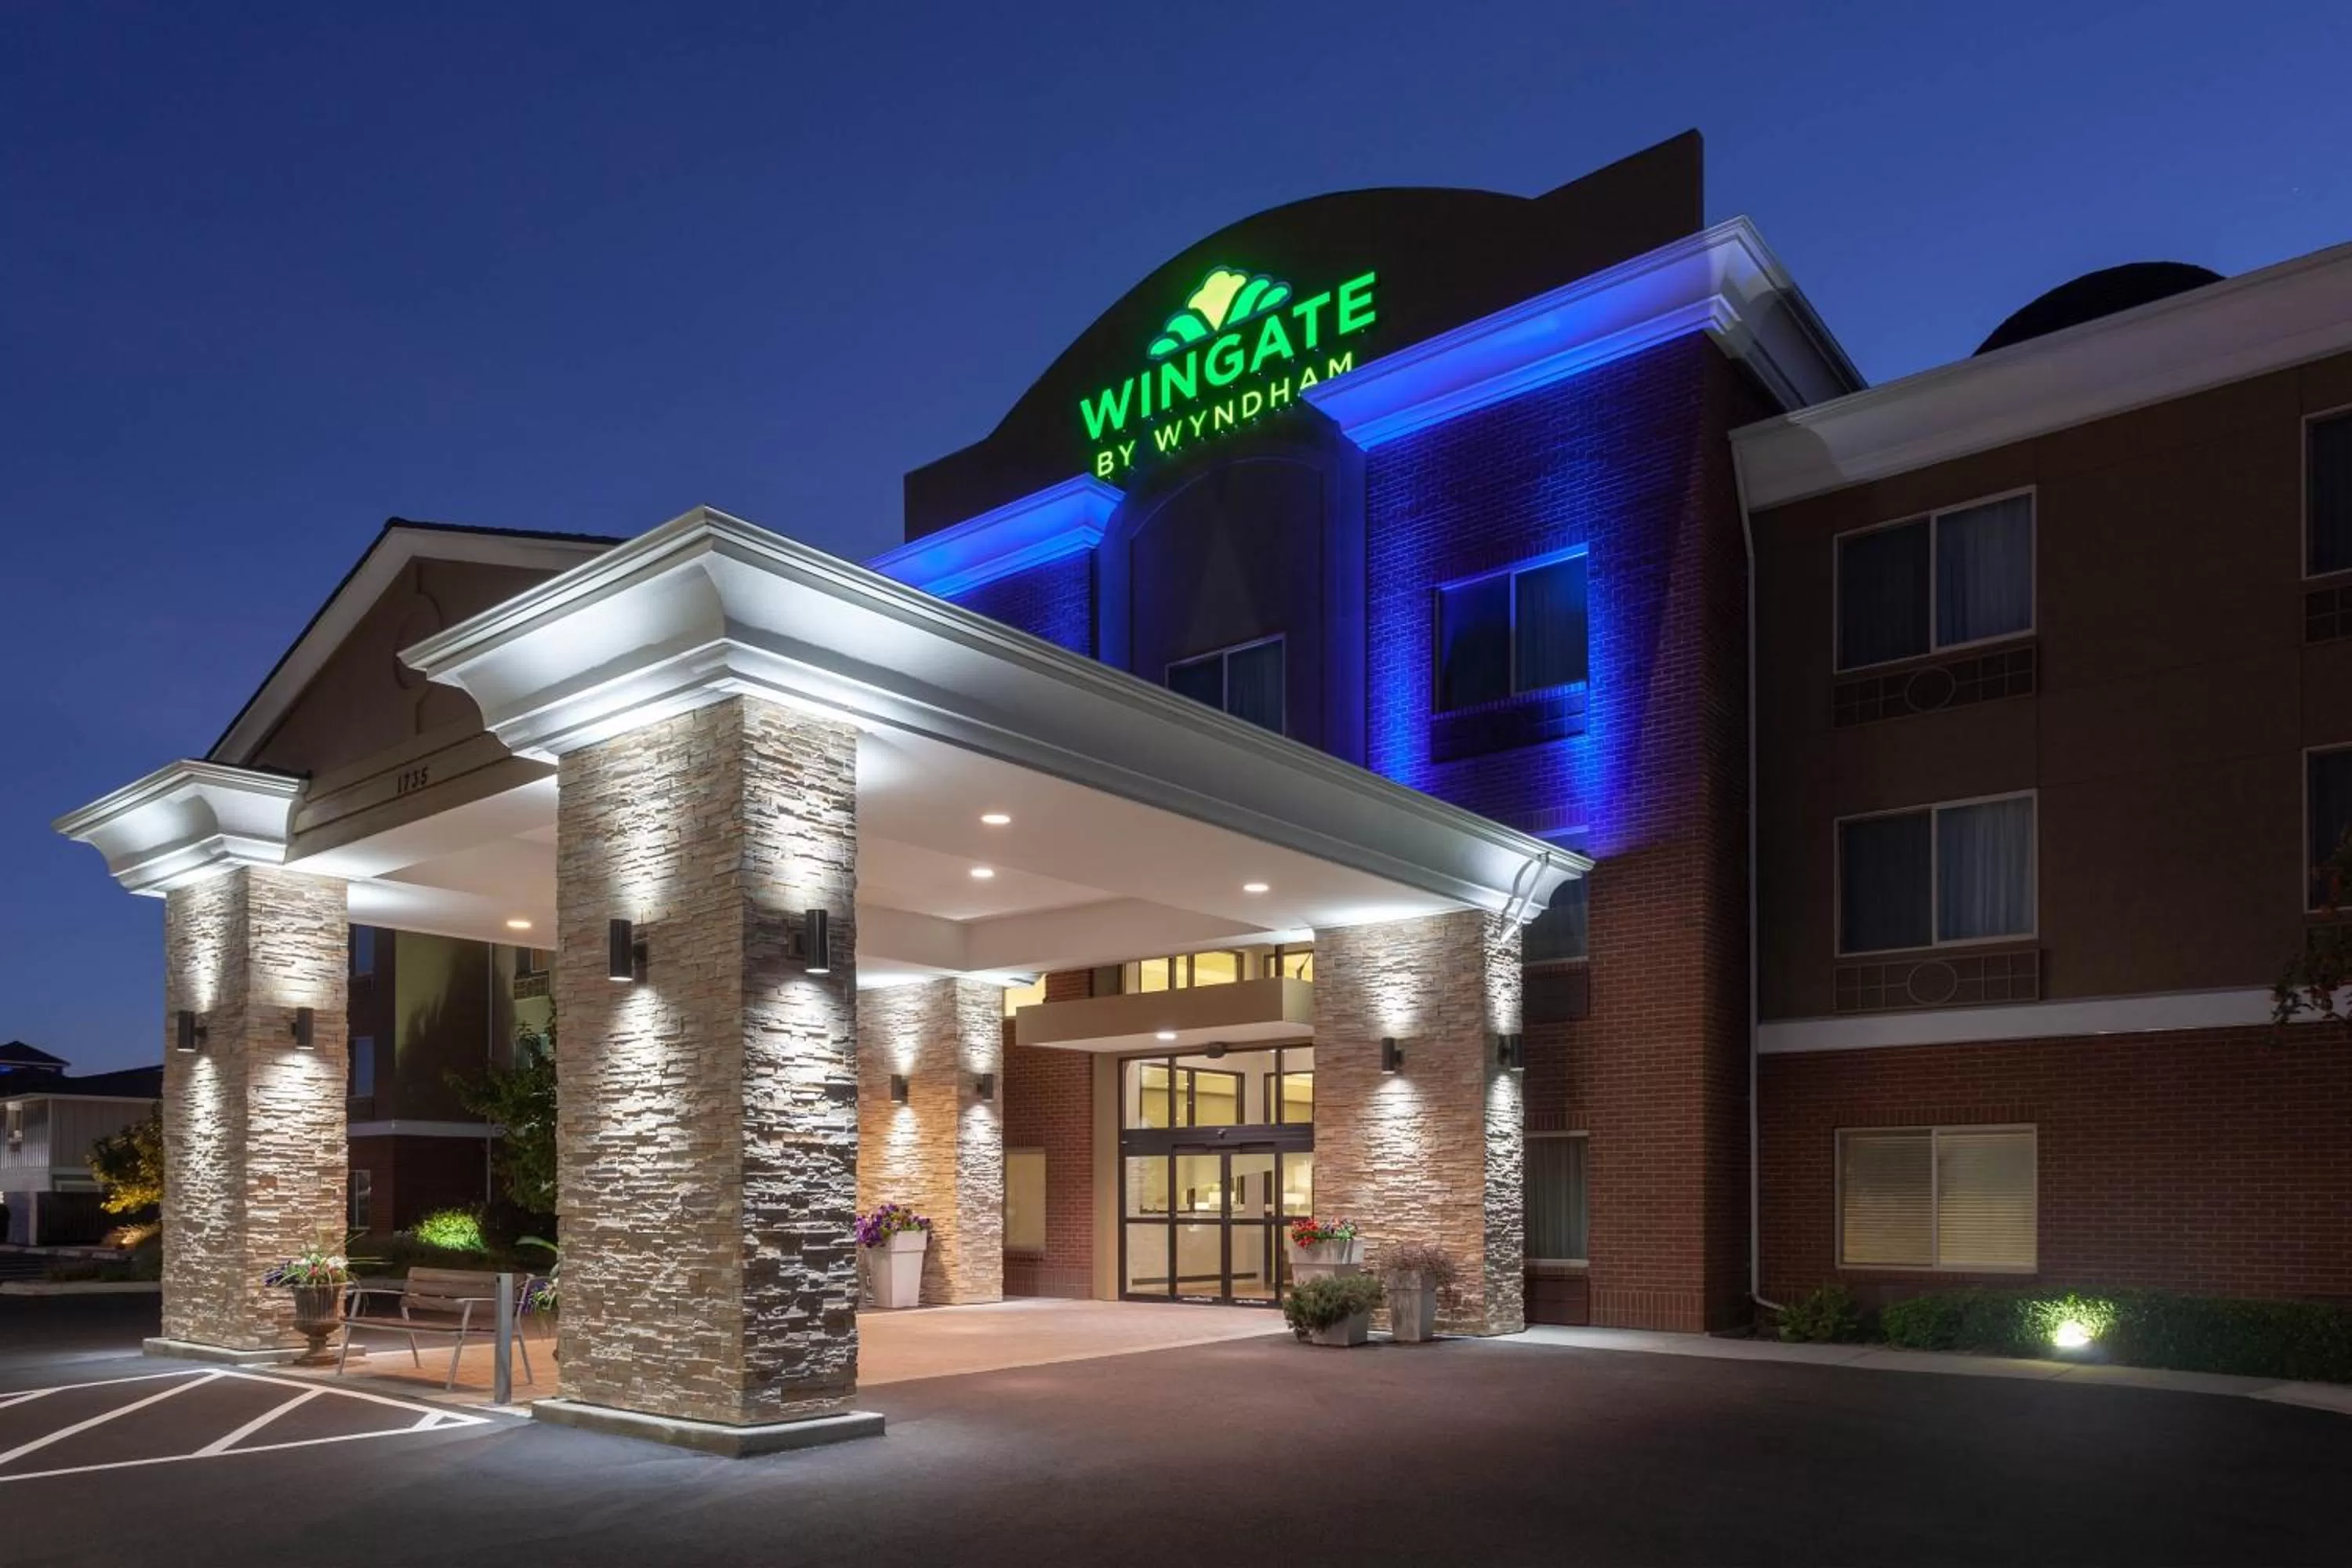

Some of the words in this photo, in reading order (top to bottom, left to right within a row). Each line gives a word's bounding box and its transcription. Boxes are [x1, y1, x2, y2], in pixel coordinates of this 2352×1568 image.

[1080, 271, 1376, 439] WINGATE
[1098, 440, 1135, 477] BY
[1154, 351, 1352, 452] WYNDHAM
